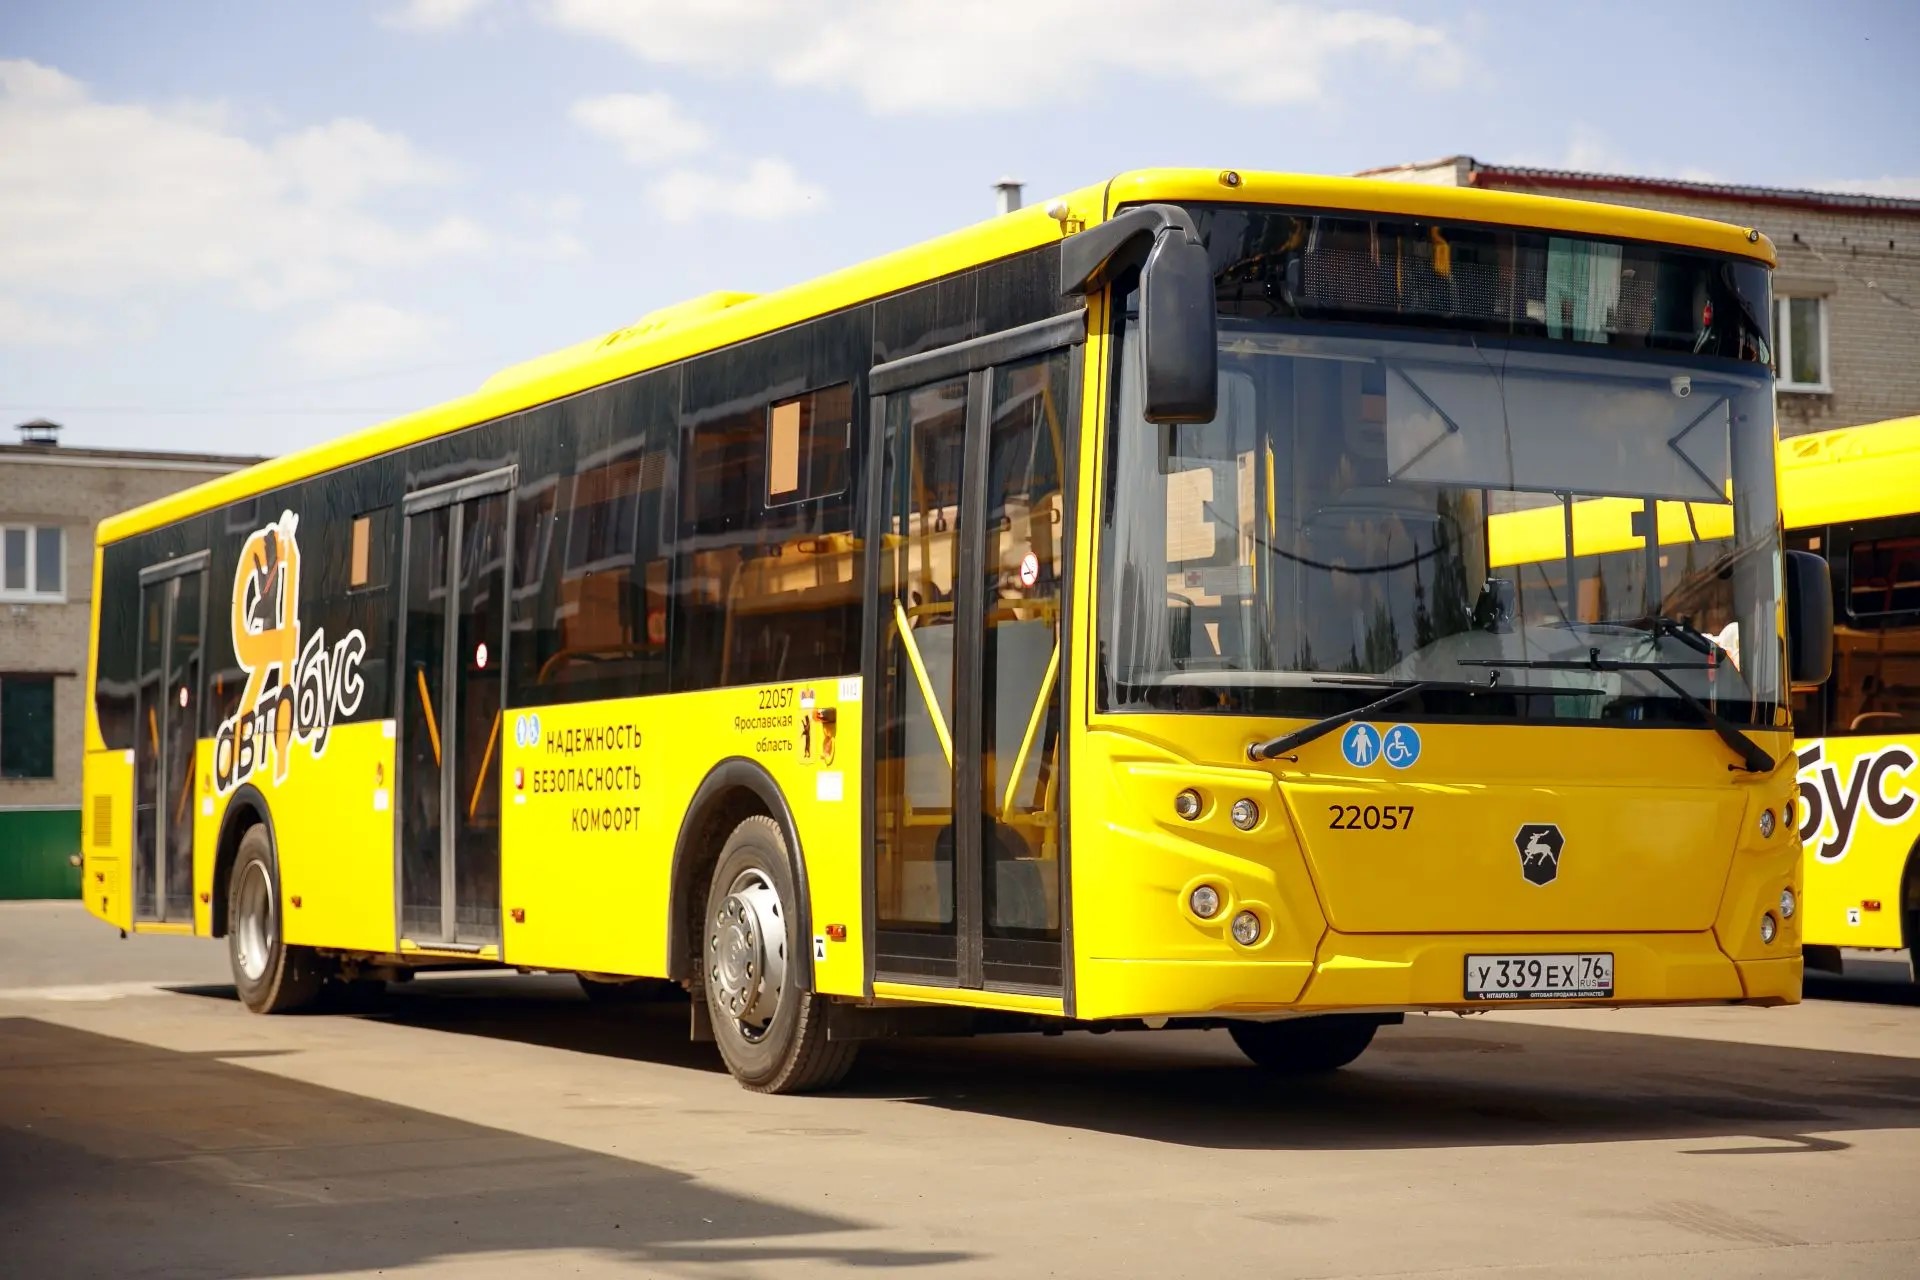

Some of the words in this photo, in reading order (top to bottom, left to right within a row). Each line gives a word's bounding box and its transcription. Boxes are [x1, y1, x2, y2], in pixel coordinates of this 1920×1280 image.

[759, 687, 793, 710] 22057
[734, 715, 793, 733] Ярославская
[546, 724, 642, 757] НАДЕЖНОСТЬ
[756, 737, 792, 752] область
[533, 765, 641, 794] БЕЗОПАСНОСТЬ
[571, 806, 640, 832] КОМФОРТ
[1329, 805, 1414, 830] 22057
[1582, 957, 1604, 979] 76
[1580, 979, 1597, 987] RUS
